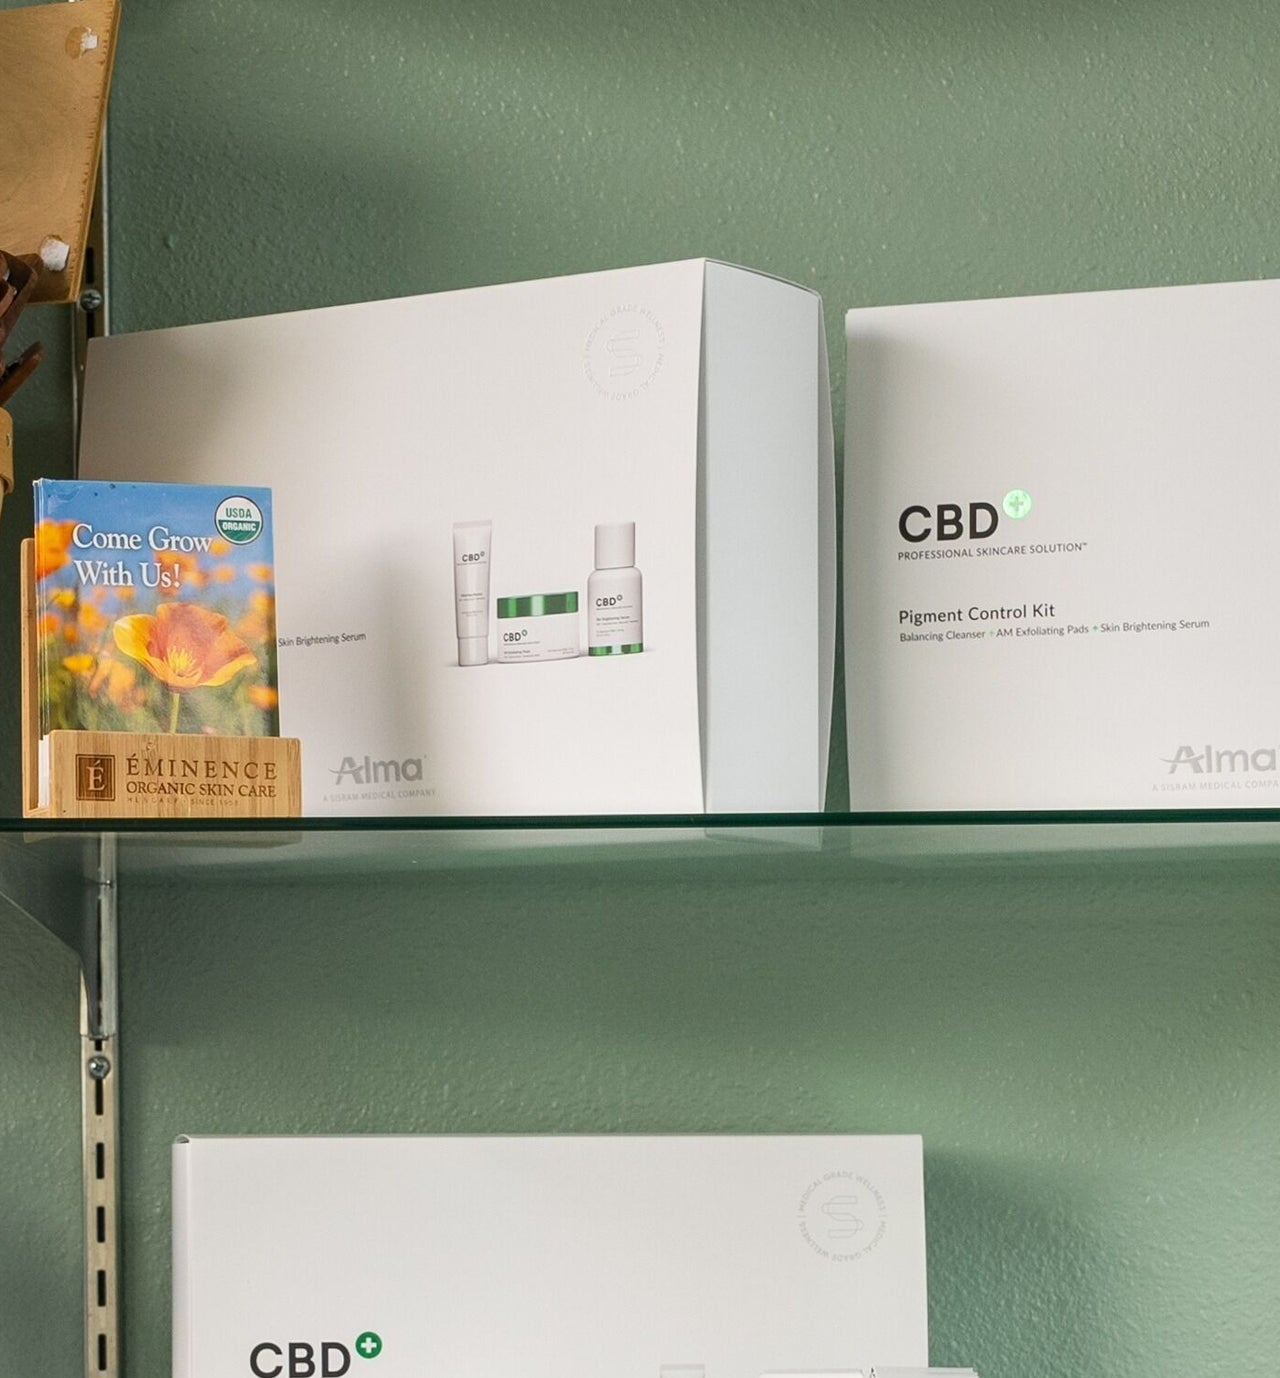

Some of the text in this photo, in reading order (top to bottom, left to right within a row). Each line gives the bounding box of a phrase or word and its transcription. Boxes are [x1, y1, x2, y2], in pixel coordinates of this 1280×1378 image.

[225, 507, 252, 519] USDA
[898, 501, 1000, 544] CBD
[72, 524, 212, 553] Come Grow
[222, 522, 256, 533] ORGANIC
[898, 548, 973, 561] PROFESSIONAL
[976, 545, 1026, 558] SKINCARE
[75, 560, 181, 588] With Us!
[899, 601, 1056, 627] Pigment Control Kit
[278, 633, 366, 648] Skin Brightening Serum
[899, 618, 1210, 643] Balancing Cleanser AM Exfoliating Pads Skin Brightening Serum
[126, 754, 277, 780] ÉMINENCE
[329, 756, 424, 785] Alma
[1160, 745, 1278, 774] Alma
[126, 783, 276, 797] ORGANIC SKIN CARE
